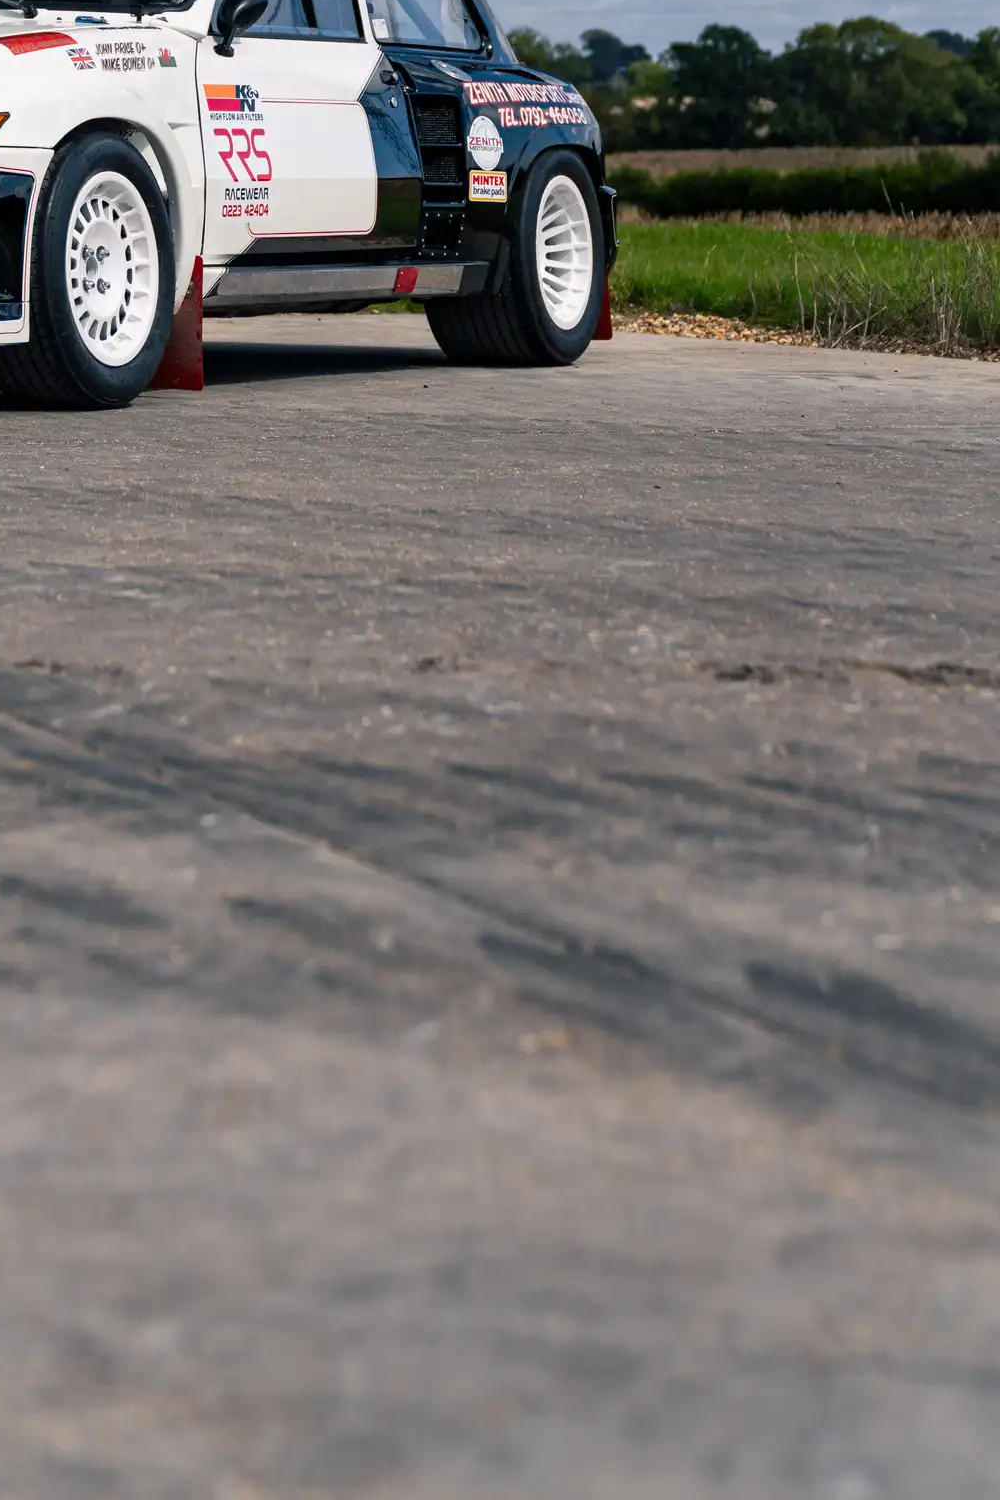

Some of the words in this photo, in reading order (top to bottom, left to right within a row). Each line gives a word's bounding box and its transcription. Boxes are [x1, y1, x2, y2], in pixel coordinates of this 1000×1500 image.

[95, 43, 113, 56] JOHN
[114, 42, 135, 54] PRICE
[101, 57, 121, 71] MIKE
[122, 56, 146, 72] BOWEN
[462, 81, 509, 105] ZENITH
[501, 82, 567, 103] MOTORSPORT
[210, 112, 222, 121] HIGH
[223, 112, 236, 121] FLOW
[236, 112, 245, 121] AIR
[245, 113, 264, 121] FILTERS
[468, 136, 502, 147] ZENITH
[472, 174, 505, 187] MINTEX
[224, 187, 269, 201] RACEWEAR
[472, 186, 490, 195] brake
[491, 187, 505, 197] pads
[221, 204, 242, 218] 0223
[243, 203, 269, 217] 42404
